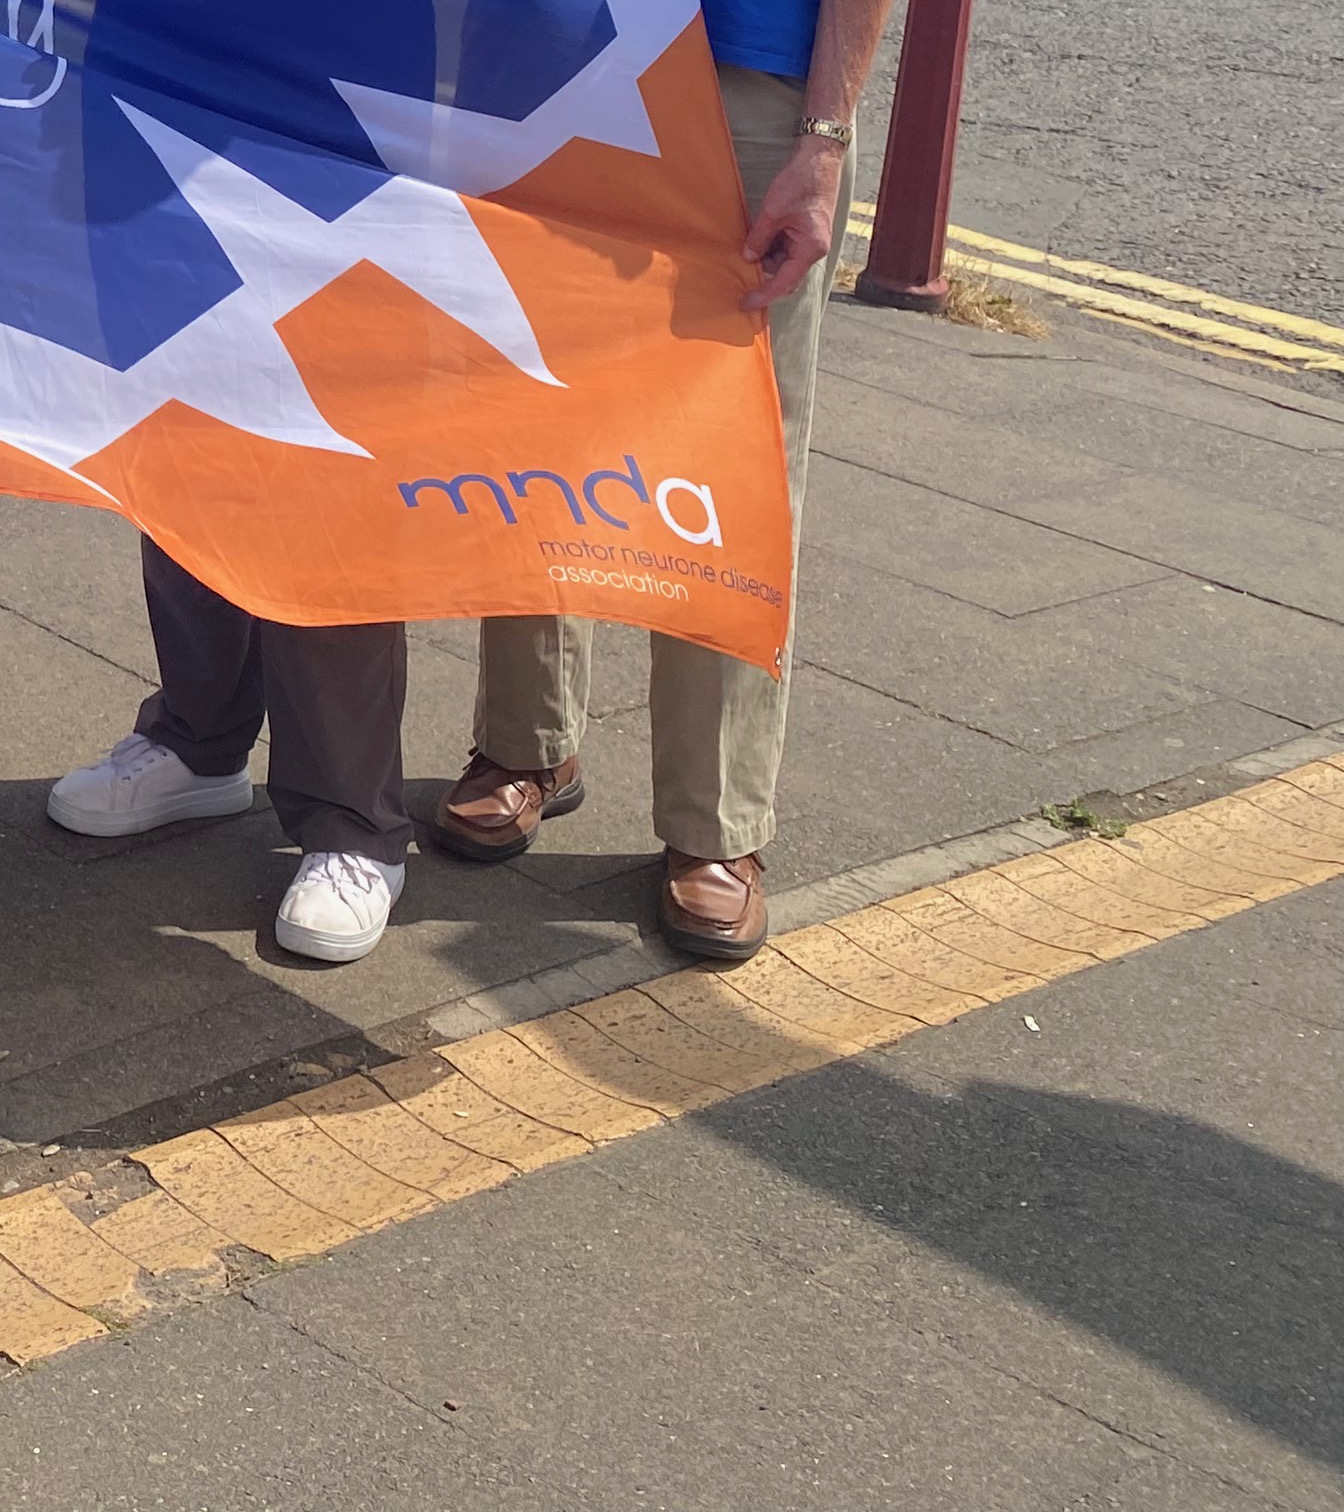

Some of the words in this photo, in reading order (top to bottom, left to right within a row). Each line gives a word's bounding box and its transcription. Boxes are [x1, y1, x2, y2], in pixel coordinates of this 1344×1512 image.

[396, 454, 723, 548] mnda
[539, 538, 615, 563] motor
[621, 544, 716, 583] neurone
[720, 567, 783, 609] disease
[548, 563, 690, 602] association
